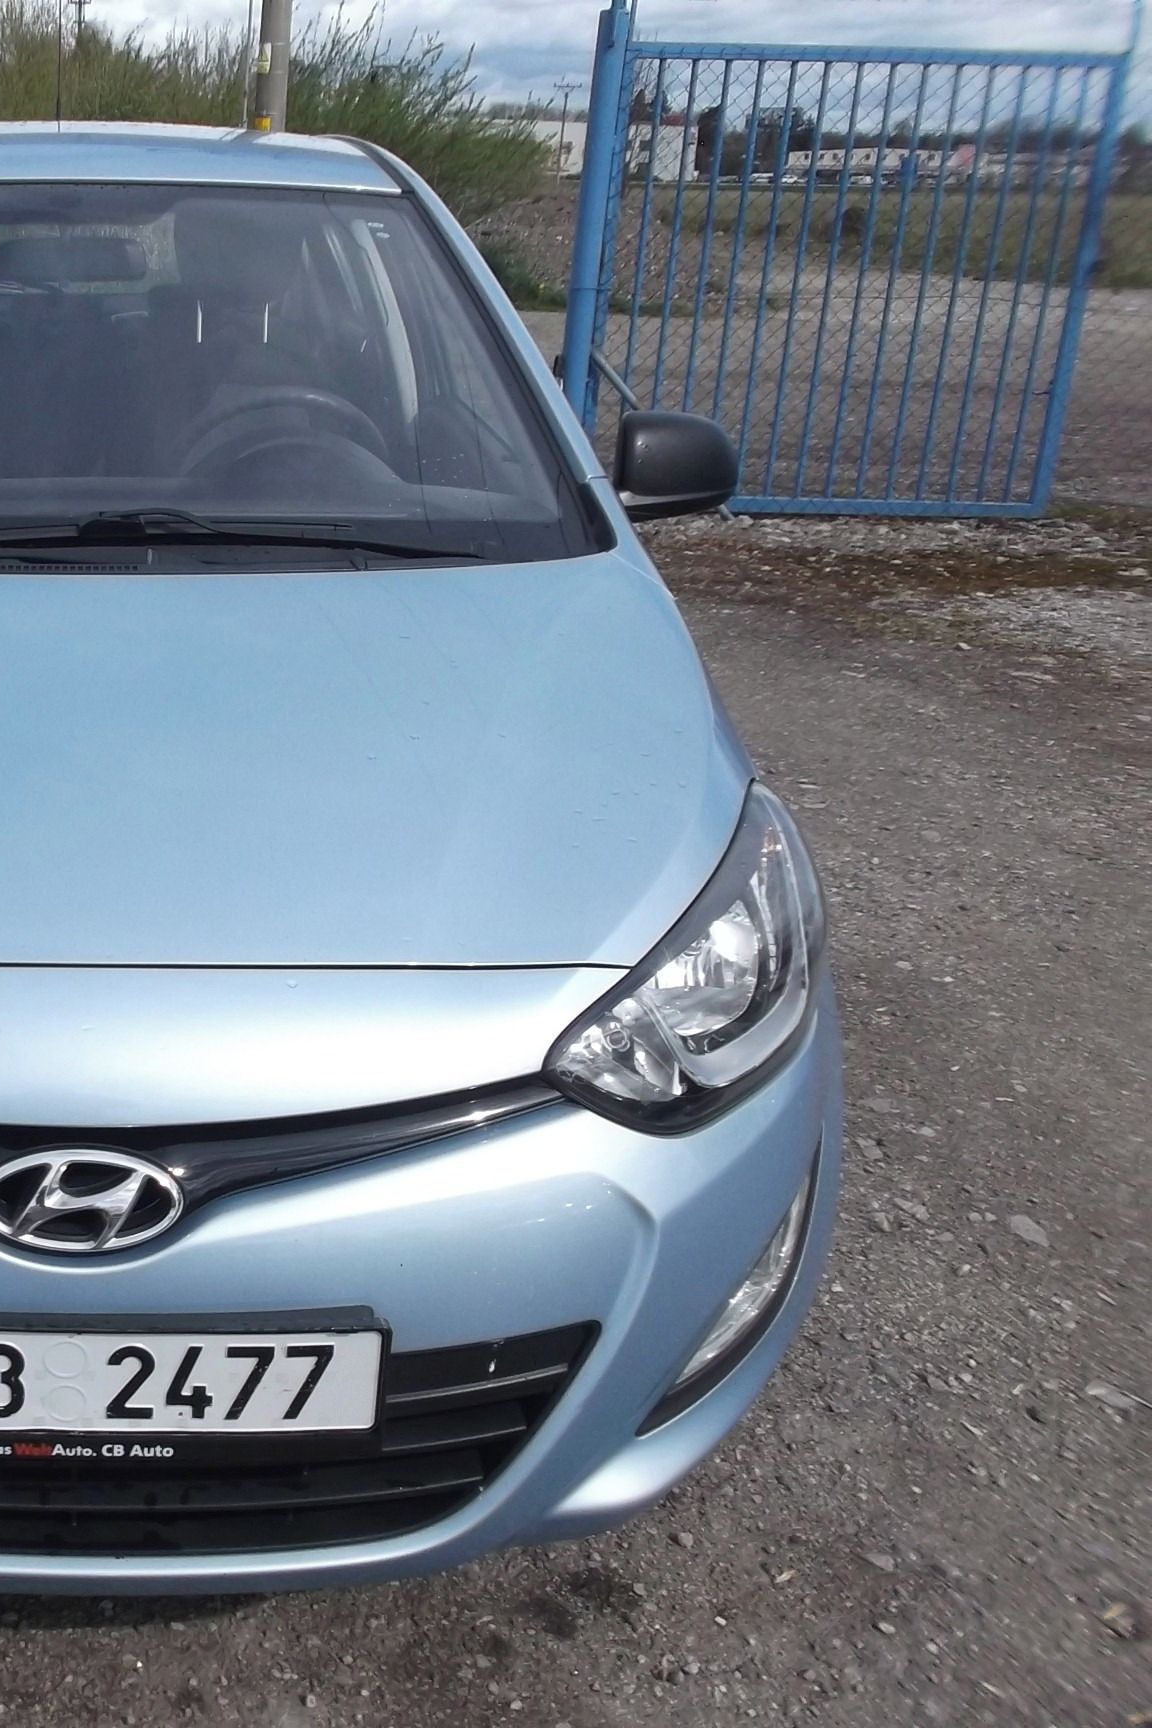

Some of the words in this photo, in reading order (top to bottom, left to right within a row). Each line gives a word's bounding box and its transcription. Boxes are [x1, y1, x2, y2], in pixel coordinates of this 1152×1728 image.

[106, 1343, 335, 1420] 2477
[101, 1444, 125, 1457] CB
[129, 1444, 174, 1458] Auto
